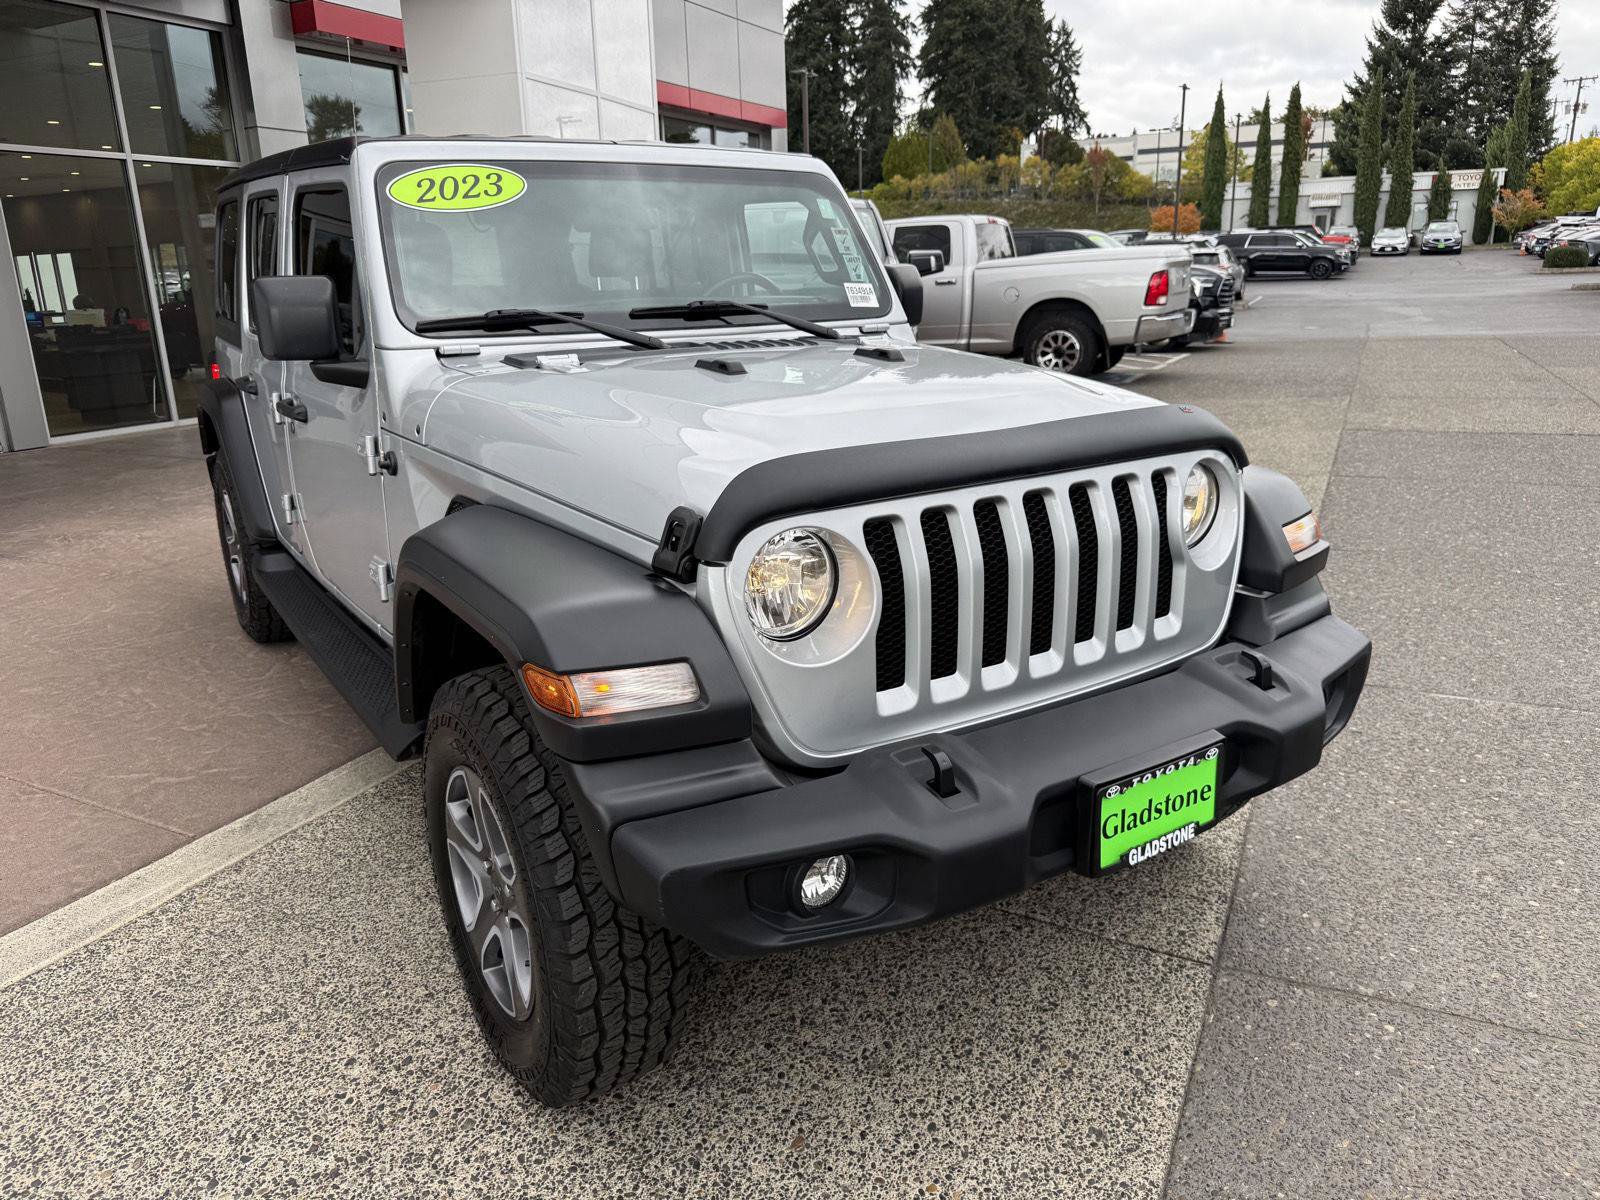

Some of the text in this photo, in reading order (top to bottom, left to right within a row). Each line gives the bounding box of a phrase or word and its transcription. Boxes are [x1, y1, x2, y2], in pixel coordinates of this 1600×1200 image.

[416, 172, 503, 204] 2023
[846, 286, 873, 295] T63491A
[1131, 756, 1195, 787] TOYOTA
[1102, 784, 1212, 840] Gladstone
[1128, 823, 1195, 866] GLADSTONE
